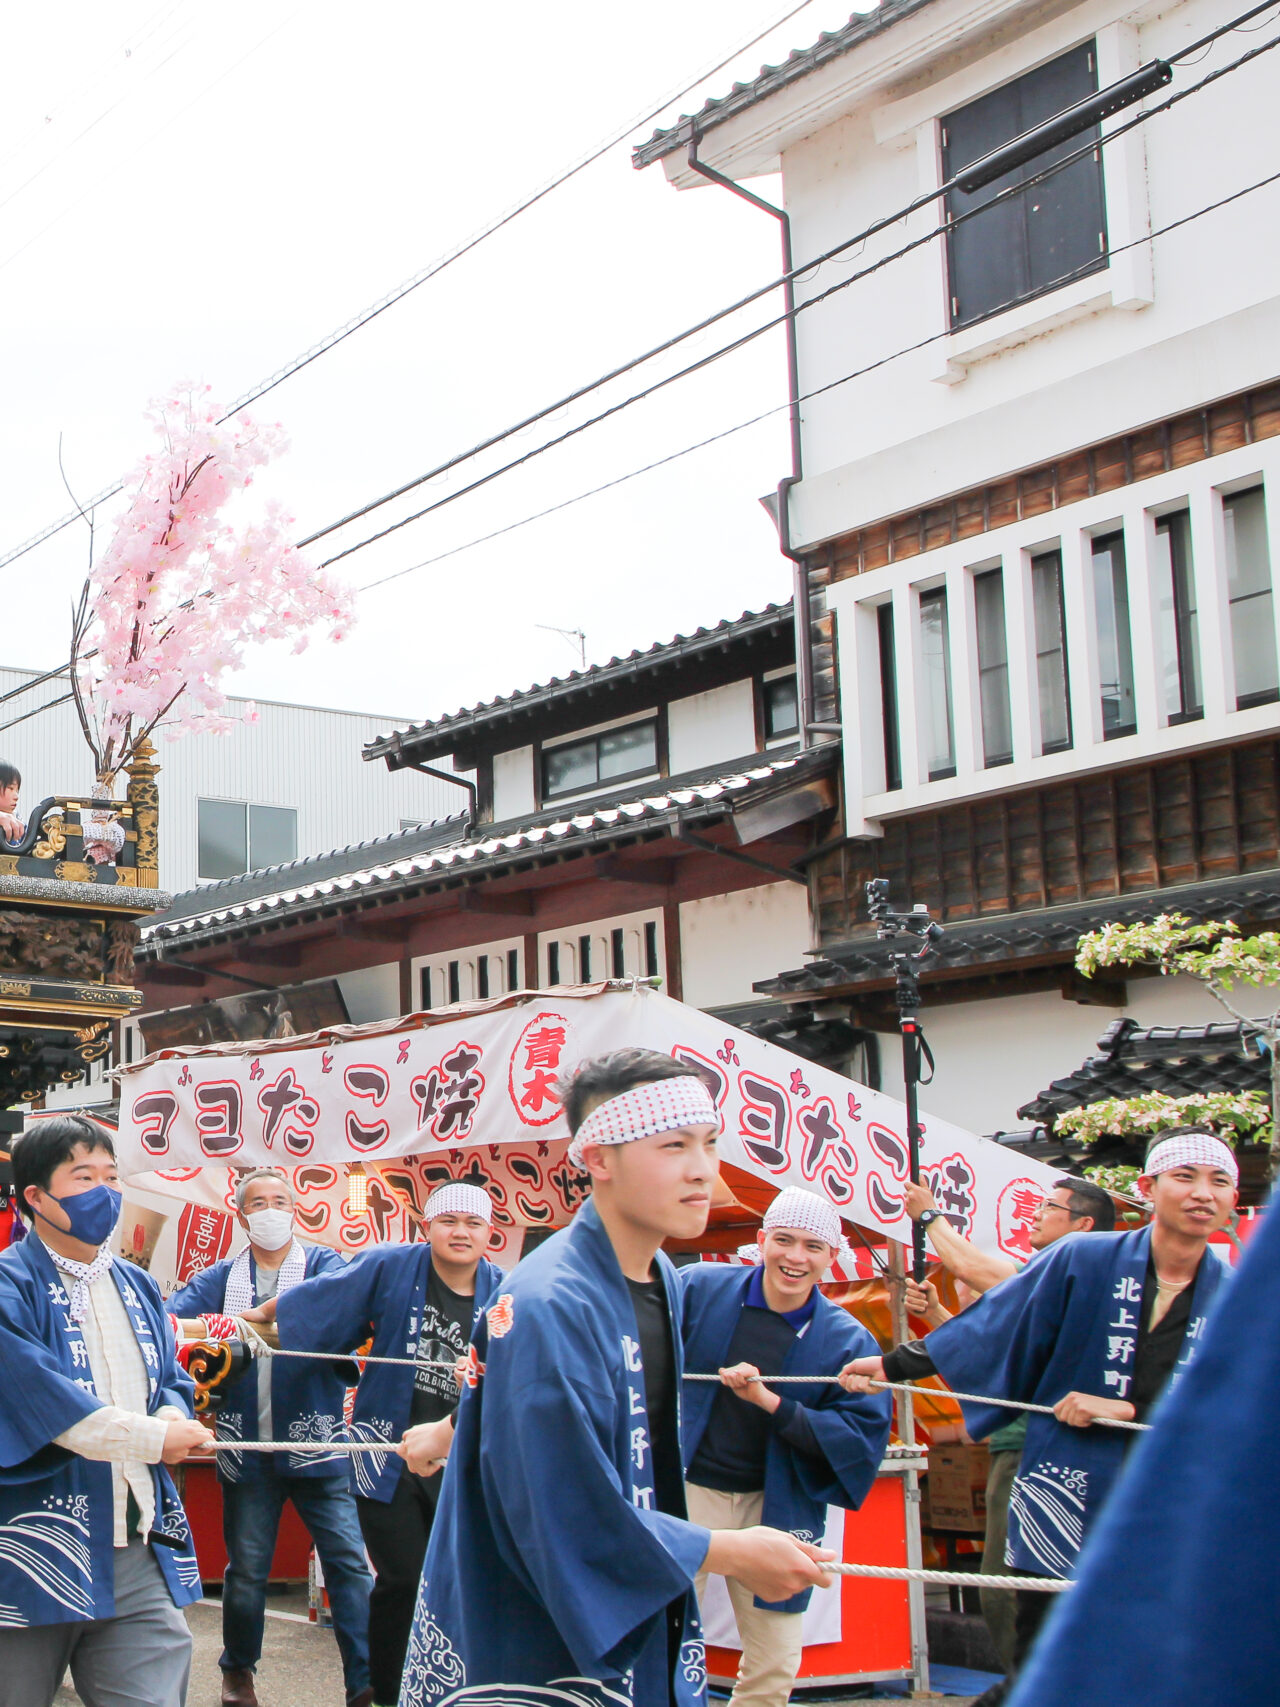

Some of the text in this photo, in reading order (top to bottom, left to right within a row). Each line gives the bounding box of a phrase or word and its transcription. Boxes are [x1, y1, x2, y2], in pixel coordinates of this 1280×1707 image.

[132, 1041, 486, 1158] マヨたこ焼
[521, 1026, 567, 1112] 青木
[1103, 1276, 1142, 1398] 北上野町
